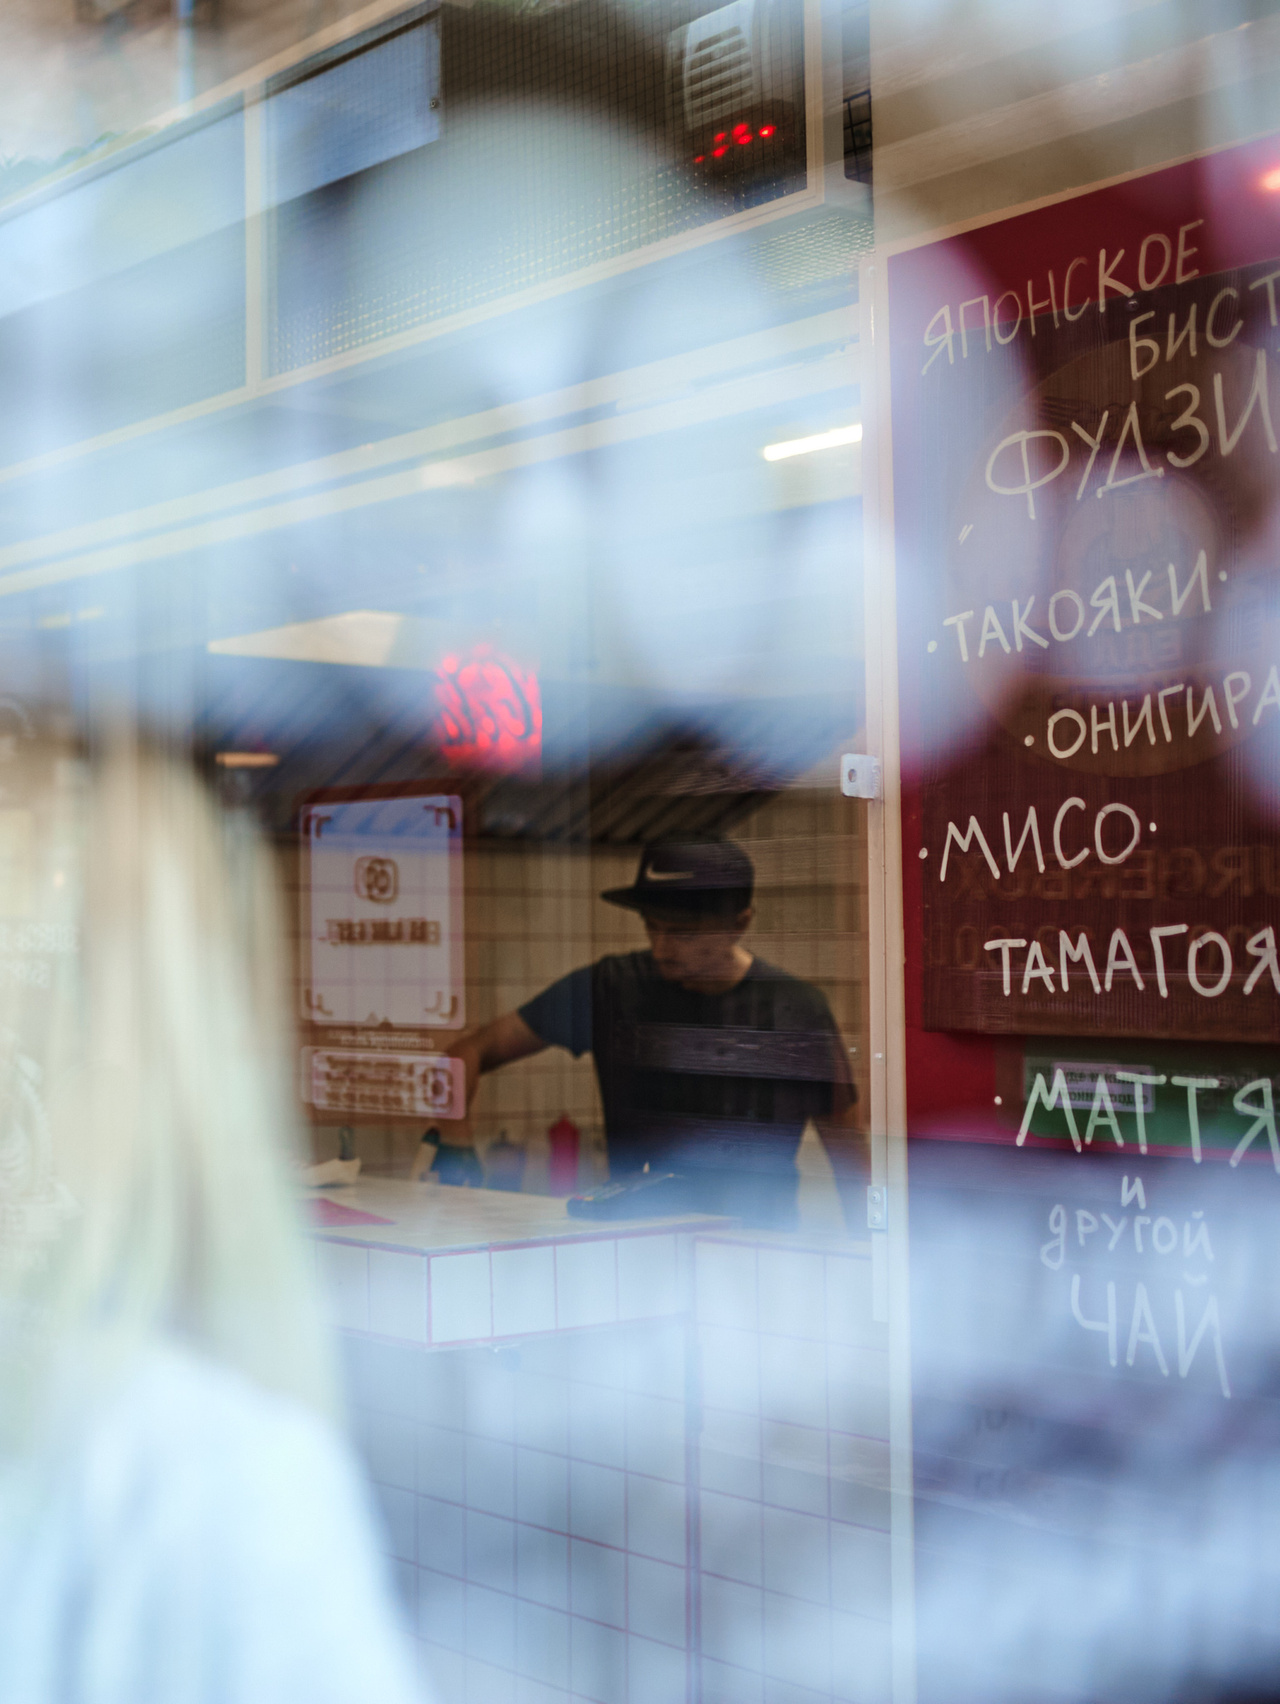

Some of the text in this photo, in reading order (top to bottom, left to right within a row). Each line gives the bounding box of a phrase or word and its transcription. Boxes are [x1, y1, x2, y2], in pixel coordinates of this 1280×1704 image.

[921, 219, 1204, 376] ЯПОНСКОЕ
[940, 797, 1140, 881] МИСО
[984, 923, 1280, 998] ТАМАГОЯ
[1016, 1068, 1280, 1174] МАТТЯ
[1071, 1272, 1231, 1399] ЧАЙ
